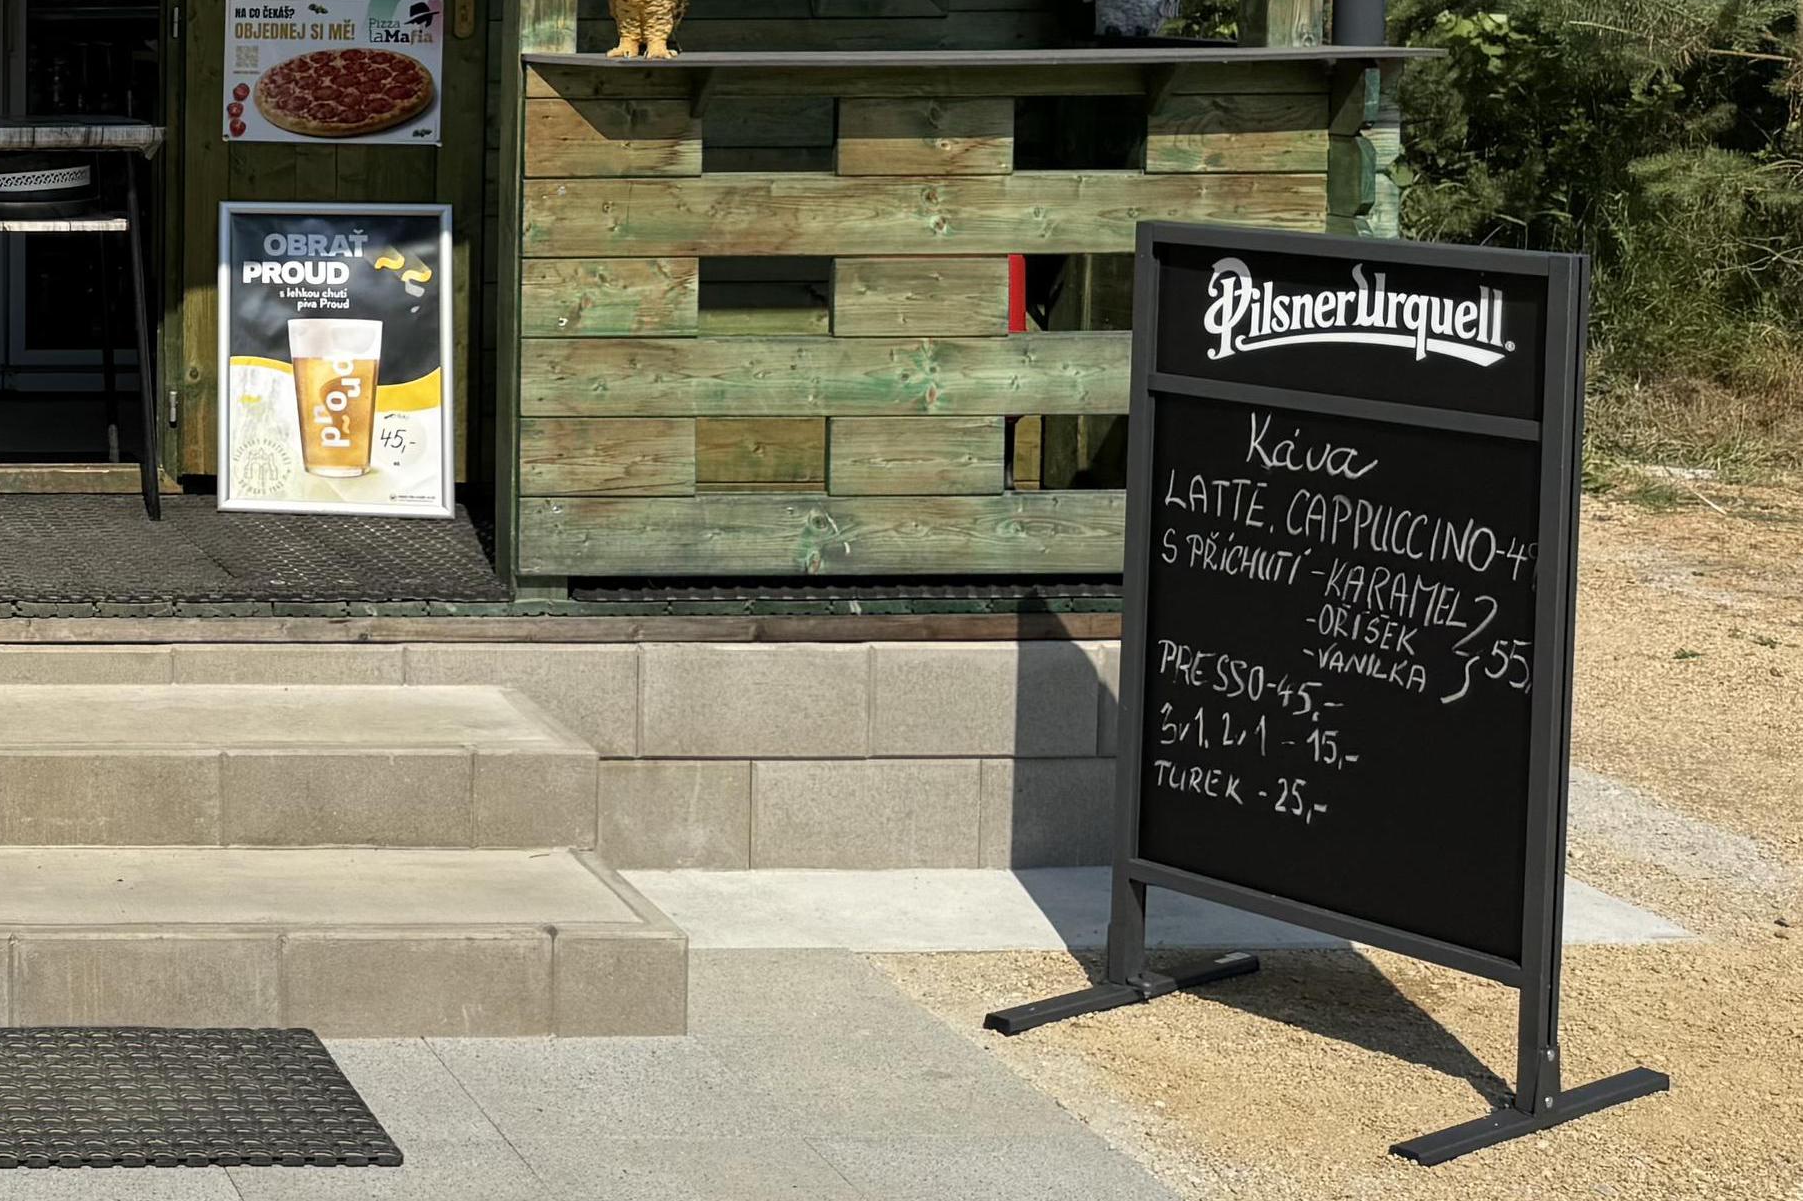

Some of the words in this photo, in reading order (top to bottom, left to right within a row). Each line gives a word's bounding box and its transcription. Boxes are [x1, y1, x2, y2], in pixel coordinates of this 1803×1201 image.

[235, 7, 247, 19] NA
[249, 7, 261, 19] CO
[262, 4, 295, 19] ČEKÁŠ?
[369, 17, 400, 29] Pizza
[234, 22, 306, 40] OBJEDNEJ
[310, 23, 324, 40] SI
[328, 18, 355, 41] MĚ!
[263, 229, 368, 258] OBRAŤ
[242, 261, 350, 285] PROUD
[279, 288, 285, 298] s
[286, 287, 320, 298] lehkou
[319, 298, 350, 310] Proud
[1203, 257, 1357, 360] Pilsner
[1351, 262, 1505, 362] Urquell
[313, 353, 362, 448] proud
[381, 428, 417, 455] 45,-
[1246, 411, 1379, 480] Káva
[1160, 527, 1178, 564] S
[1185, 531, 1312, 585] PŘÍCHUTÍ
[1153, 759, 1244, 806] TUREK
